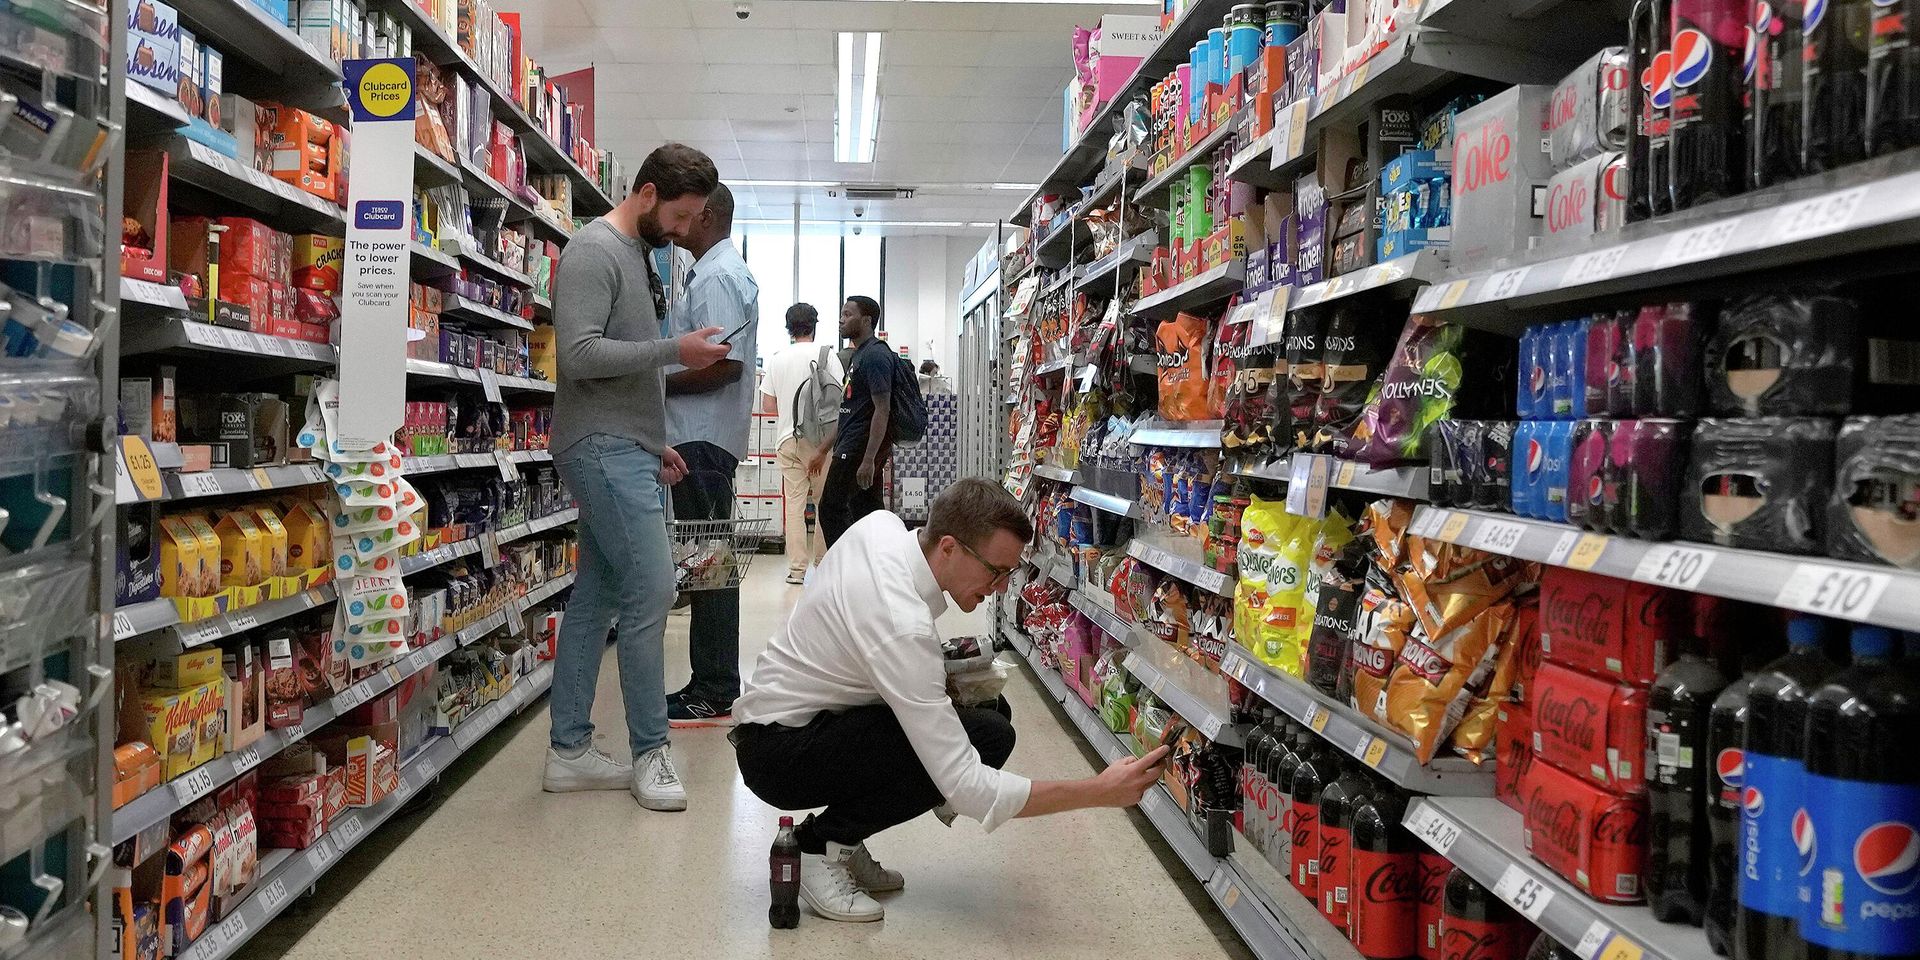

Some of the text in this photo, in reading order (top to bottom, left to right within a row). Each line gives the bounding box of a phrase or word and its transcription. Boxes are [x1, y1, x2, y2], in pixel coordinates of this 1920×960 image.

[1111, 33, 1138, 41] SWEET
[363, 80, 407, 92] Clubcard
[370, 91, 400, 101] Prices
[1551, 86, 1577, 130] Coke
[1452, 124, 1510, 196] Coke
[1549, 179, 1587, 233] Coke
[363, 213, 396, 221] Clubcard
[349, 241, 406, 252] The power
[355, 253, 399, 263] to lower
[359, 265, 396, 276] prices.
[351, 291, 365, 299] you
[374, 282, 394, 290] when
[130, 453, 152, 471] £1.25
[196, 475, 220, 493] £1.15
[904, 490, 923, 498] £4.50
[1656, 554, 1705, 586] £10
[355, 576, 392, 591] JERKY
[1809, 575, 1869, 616] £10
[114, 612, 131, 635] .70
[188, 769, 211, 796] £1.15
[1425, 818, 1457, 849] £4.70
[1745, 818, 1760, 881] pepsi
[265, 879, 286, 906] £1.15
[1513, 879, 1543, 911] £5
[221, 914, 243, 941] £2.55
